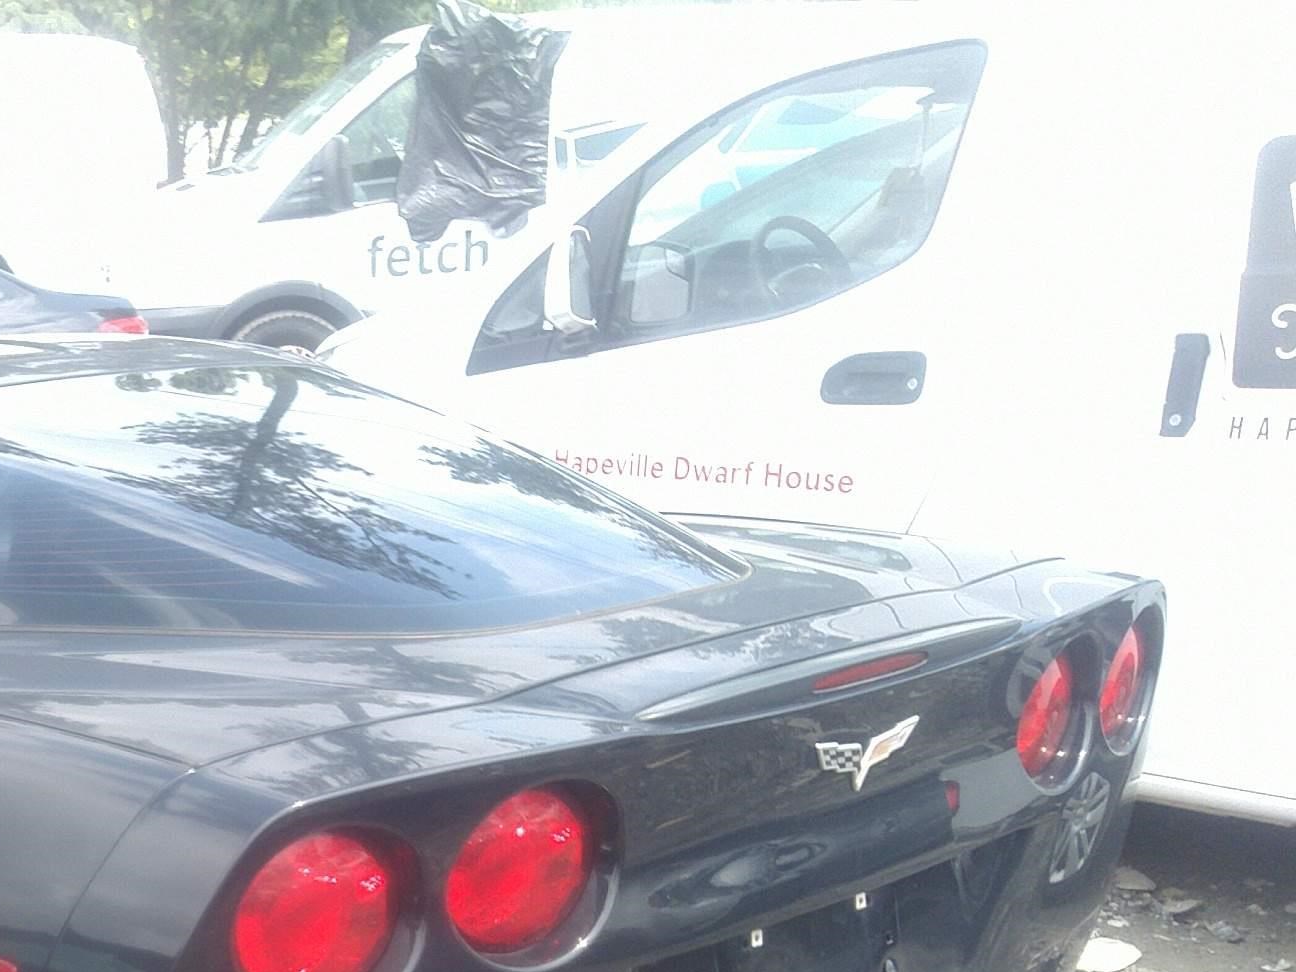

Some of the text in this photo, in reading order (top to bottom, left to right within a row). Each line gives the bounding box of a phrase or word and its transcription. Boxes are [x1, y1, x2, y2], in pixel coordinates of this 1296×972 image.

[367, 229, 489, 278] fetch
[555, 448, 854, 494] Hapeville Dwarf House
